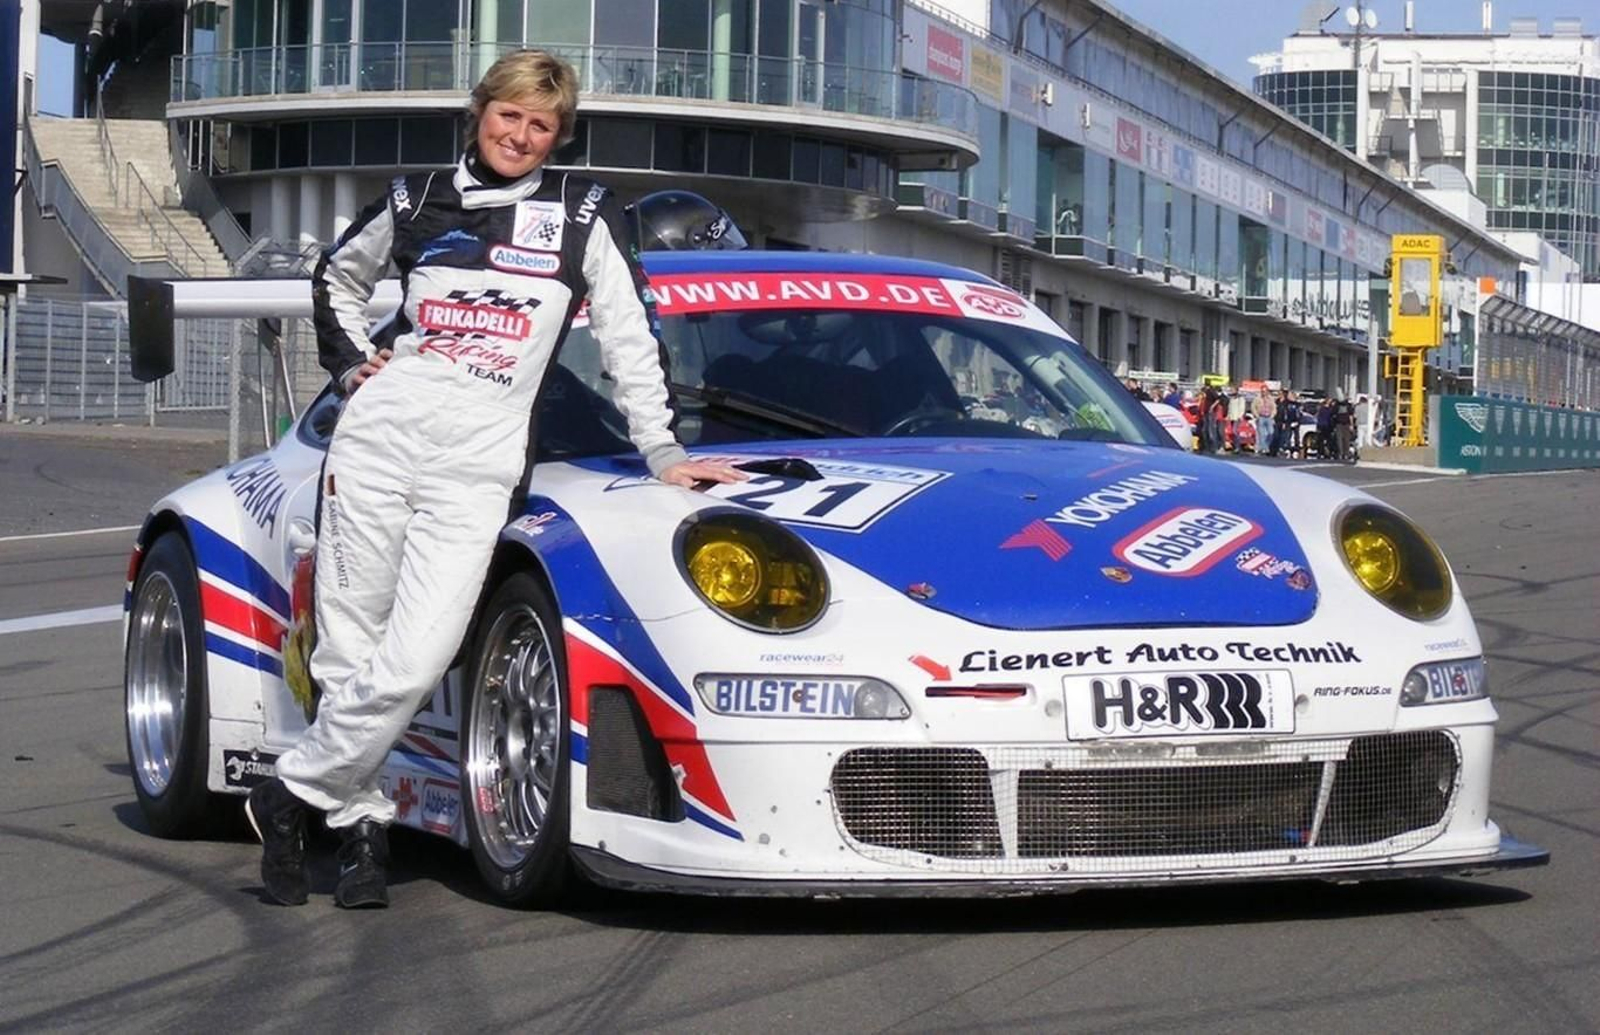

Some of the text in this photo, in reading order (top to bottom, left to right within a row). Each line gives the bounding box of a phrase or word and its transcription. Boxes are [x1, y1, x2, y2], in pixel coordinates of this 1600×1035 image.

[575, 183, 607, 225] uvex
[493, 248, 556, 270] Abbelen
[1401, 239, 1431, 249] ADAC
[424, 302, 526, 337] FRIKADELLI
[465, 363, 513, 387] TEAM
[1045, 469, 1200, 528] YOKOHAMA
[1132, 511, 1243, 570] Abbelen
[958, 641, 1362, 673] Lienert Auto Technik
[716, 679, 855, 717] BILSTEIN
[1092, 676, 1205, 729] H&R
